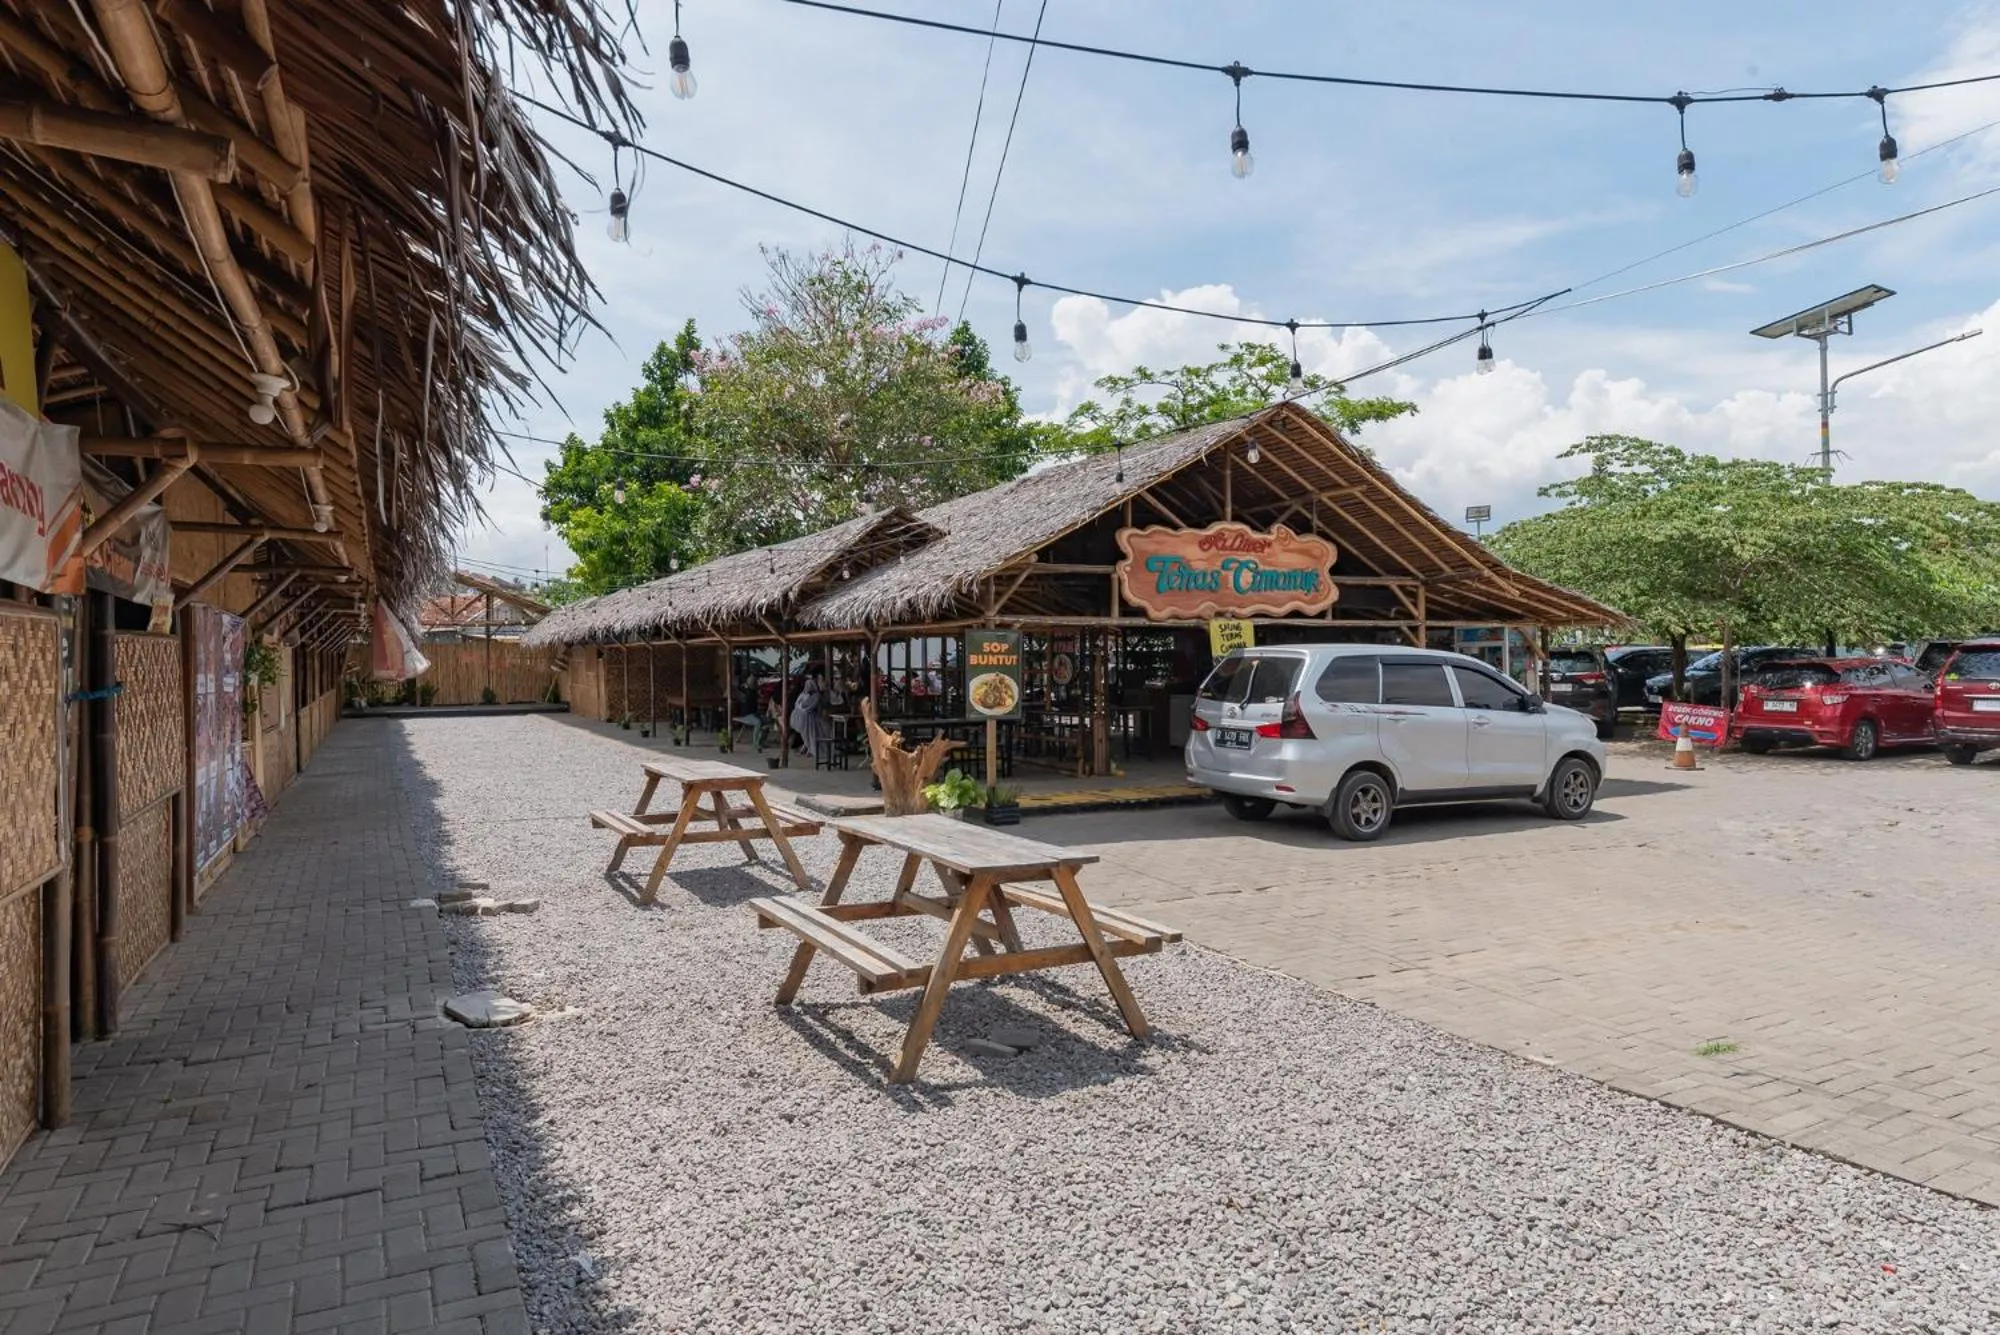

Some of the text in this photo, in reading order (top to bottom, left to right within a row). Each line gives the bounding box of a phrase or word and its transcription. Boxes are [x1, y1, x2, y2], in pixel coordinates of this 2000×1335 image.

[1145, 555, 1222, 594] Teras
[982, 642, 1010, 653] SOP
[969, 653, 1019, 666] BUNTUT
